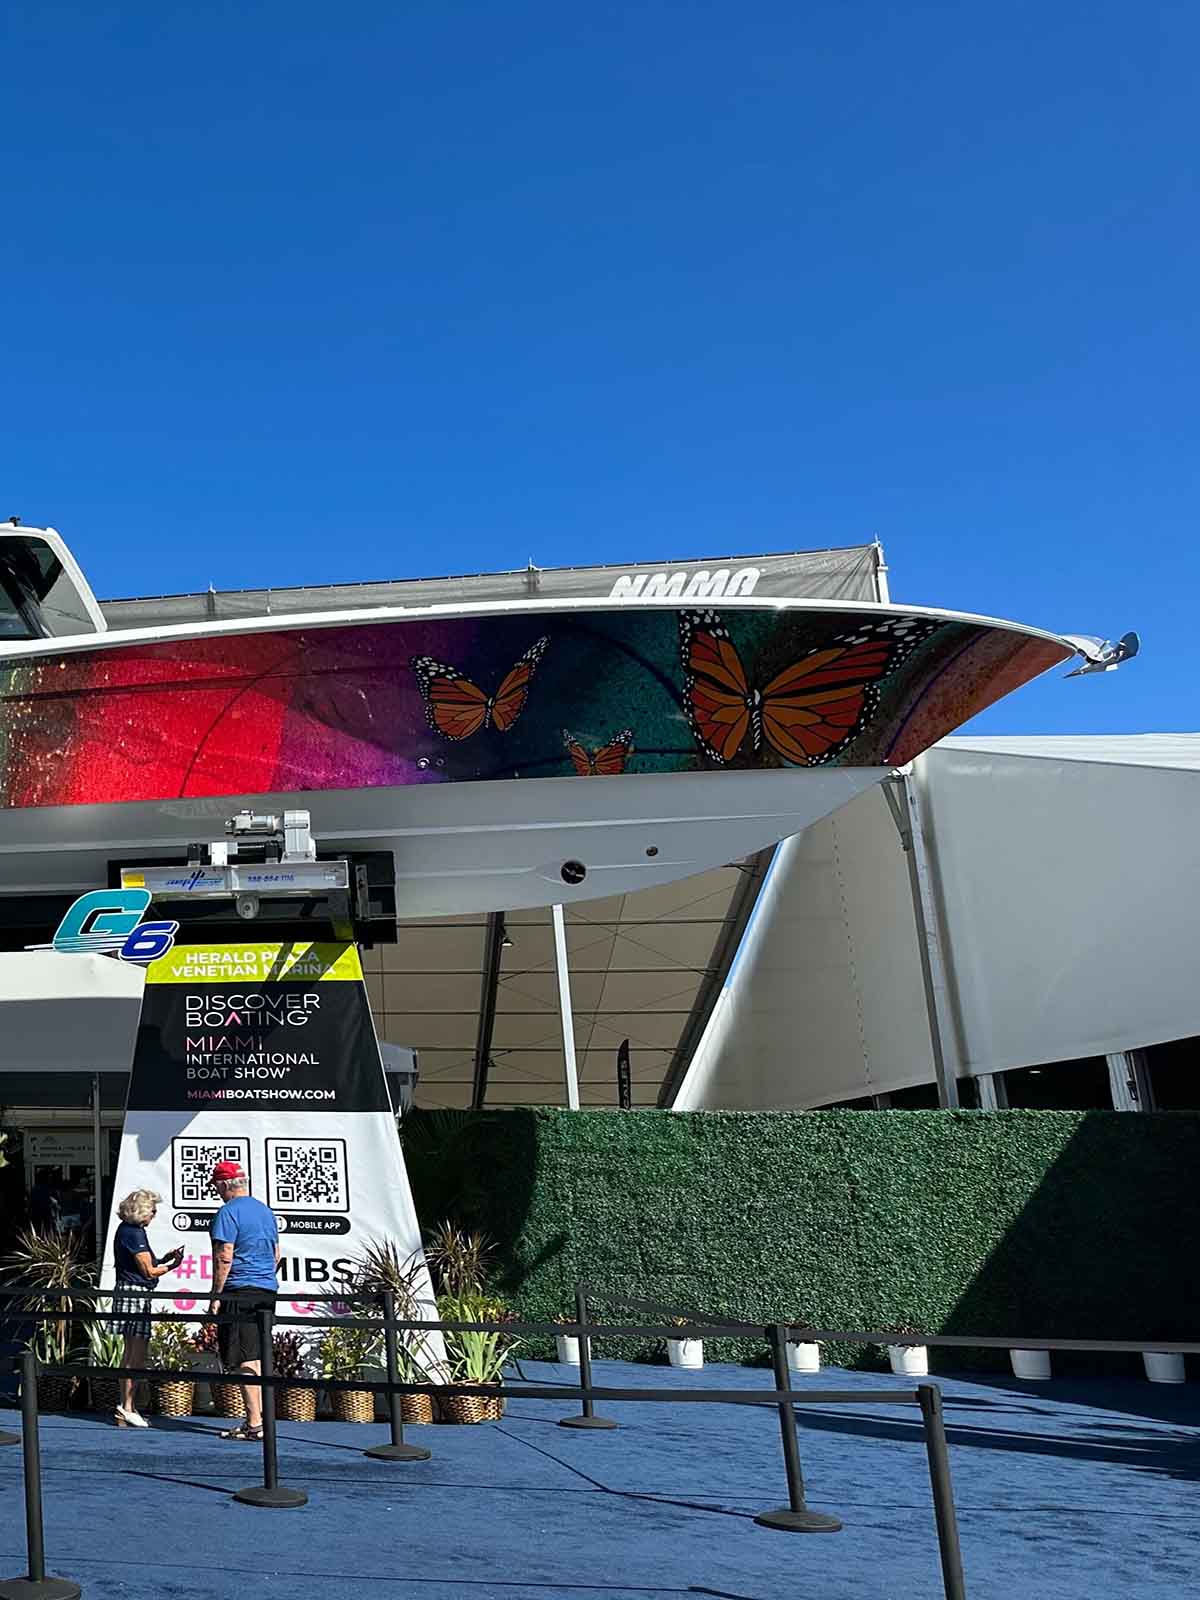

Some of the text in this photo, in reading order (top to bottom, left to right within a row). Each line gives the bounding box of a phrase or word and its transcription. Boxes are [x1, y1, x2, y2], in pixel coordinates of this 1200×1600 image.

[186, 951, 319, 964] HERALD PLAZA
[172, 963, 336, 977] VENETIAN MARINA
[186, 994, 320, 1010] DISCOVER
[186, 1036, 263, 1051] MIAMI
[186, 1053, 320, 1065] INTERNATIONAL
[186, 1067, 228, 1079] BOAT
[187, 1090, 336, 1100] MIAMIBOATSHOW.COM
[194, 1219, 210, 1227] BUY
[290, 1222, 340, 1230] MOBILE APP
